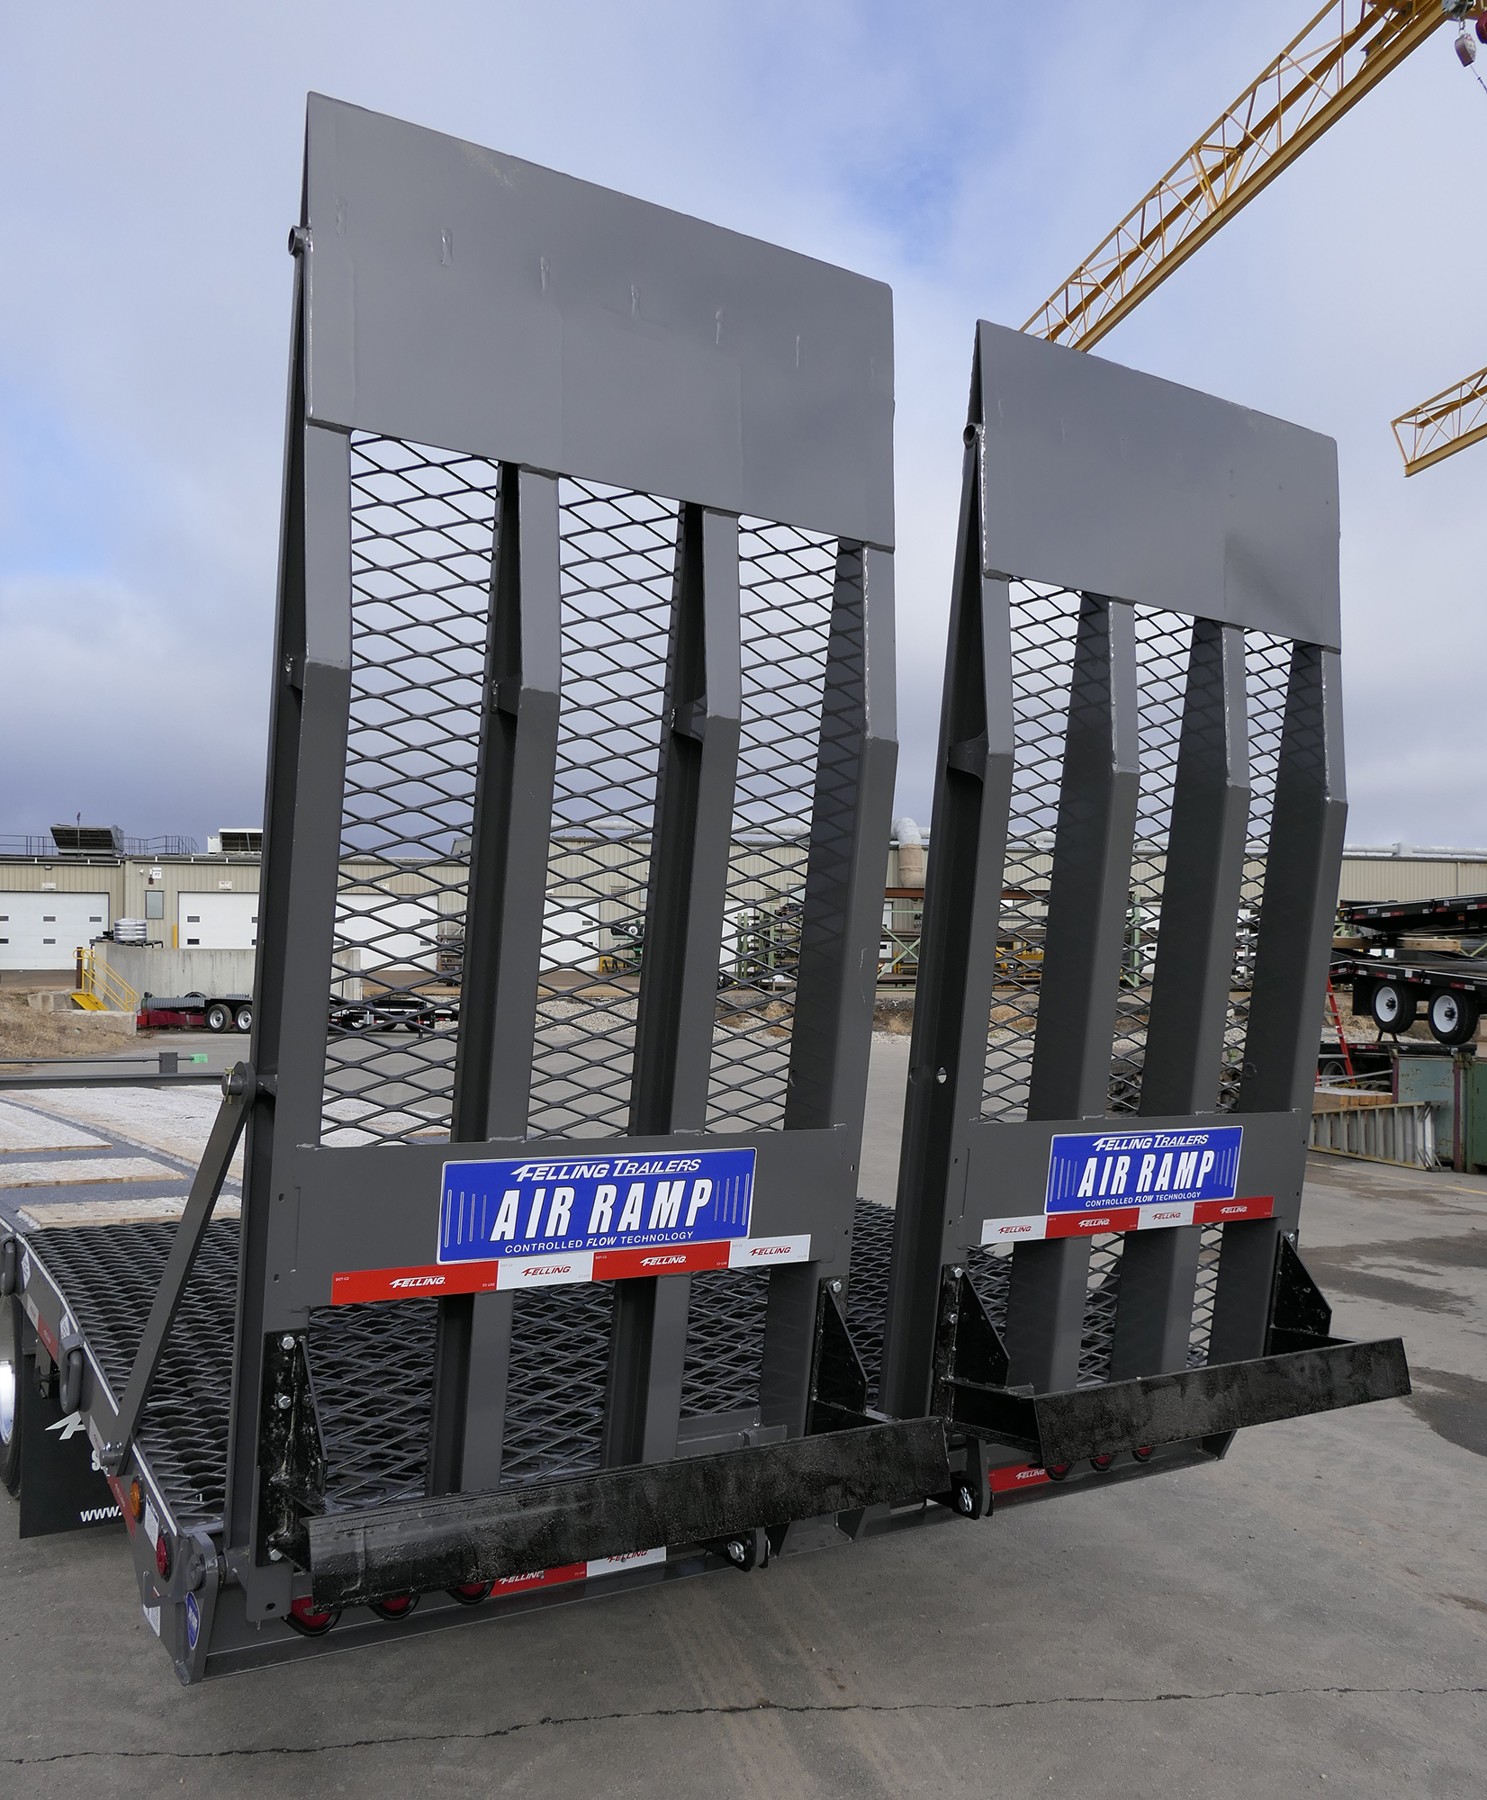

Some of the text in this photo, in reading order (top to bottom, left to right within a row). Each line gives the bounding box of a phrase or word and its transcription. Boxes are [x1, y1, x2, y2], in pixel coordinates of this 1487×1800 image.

[1092, 1134, 1209, 1151] FELLING TRAILERS
[510, 1158, 702, 1182] FELLING TRAILERS
[1077, 1150, 1215, 1198] AIR RAMP
[1085, 1191, 1201, 1208] CONTROLLED FLOW TECHNOLOGY
[489, 1178, 713, 1241] AIR RAMP
[1151, 1212, 1182, 1221] FELLING
[998, 1225, 1032, 1235] FELLING
[504, 1231, 694, 1254] CONTROLLED FLOW TECHNOLOGY
[749, 1246, 792, 1256] FELLING
[640, 1255, 687, 1266] FELLING
[521, 1265, 572, 1276] FELLING
[389, 1275, 446, 1289] FELLING
